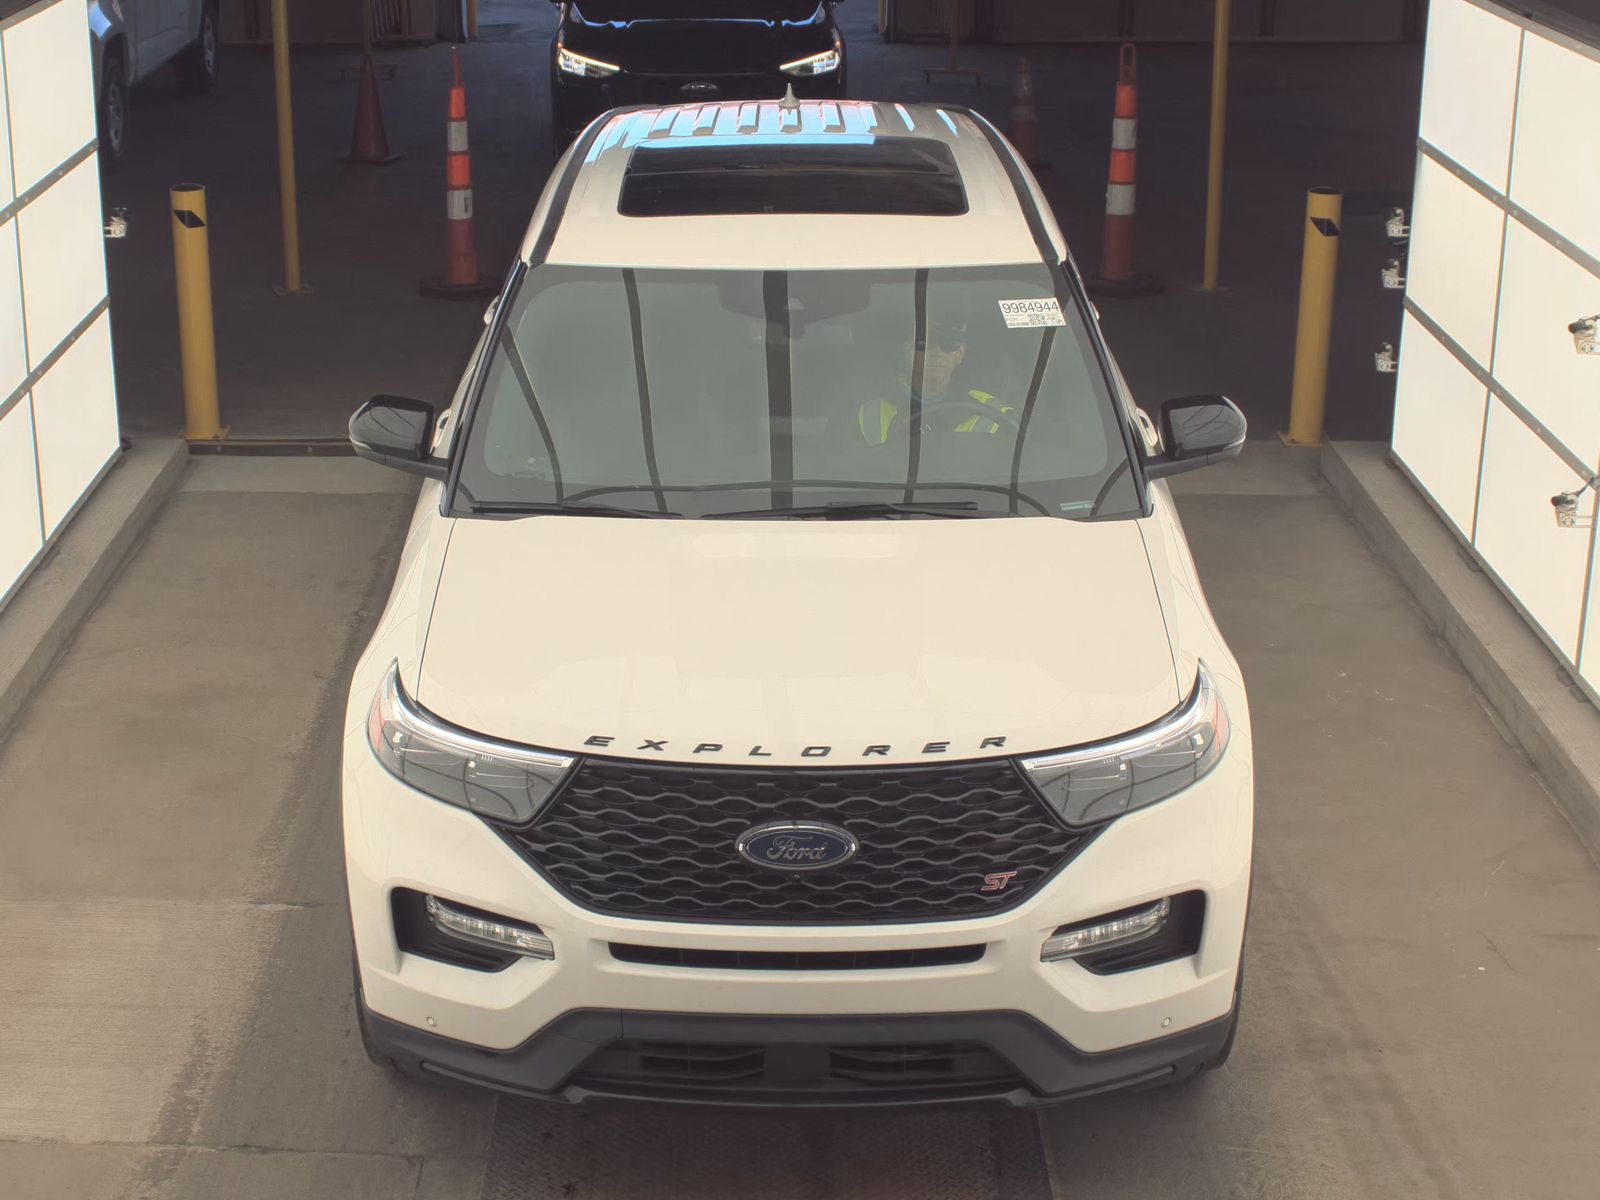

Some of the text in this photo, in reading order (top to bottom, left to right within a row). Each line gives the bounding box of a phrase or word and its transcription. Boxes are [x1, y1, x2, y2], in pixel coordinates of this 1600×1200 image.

[1002, 301, 1059, 314] 9984944
[584, 735, 1007, 757] EXPLORER
[767, 835, 828, 860] Ford
[981, 871, 1017, 891] ST
